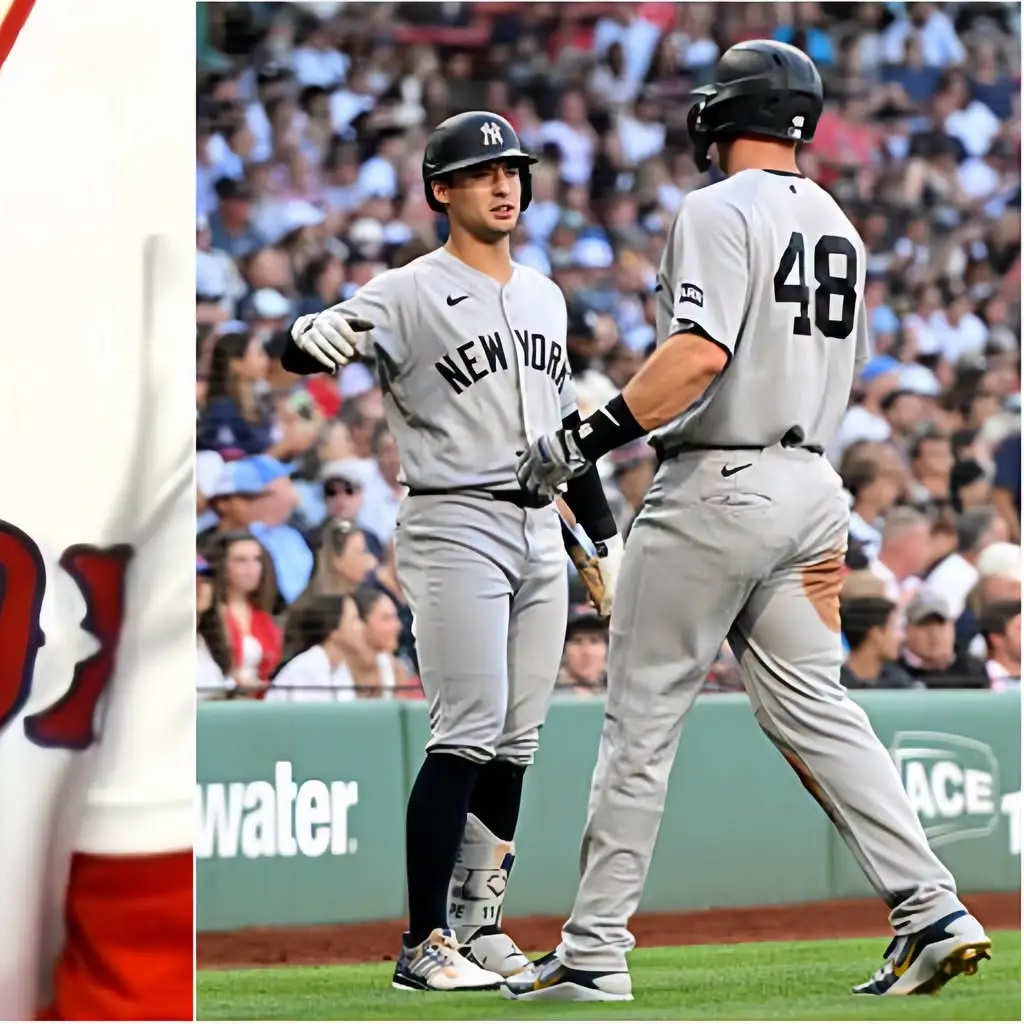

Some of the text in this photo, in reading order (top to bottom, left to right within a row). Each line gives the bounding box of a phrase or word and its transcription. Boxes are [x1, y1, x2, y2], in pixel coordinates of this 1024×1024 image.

[774, 231, 858, 339] 48
[435, 332, 508, 395] NEW
[905, 761, 994, 819] ACE
